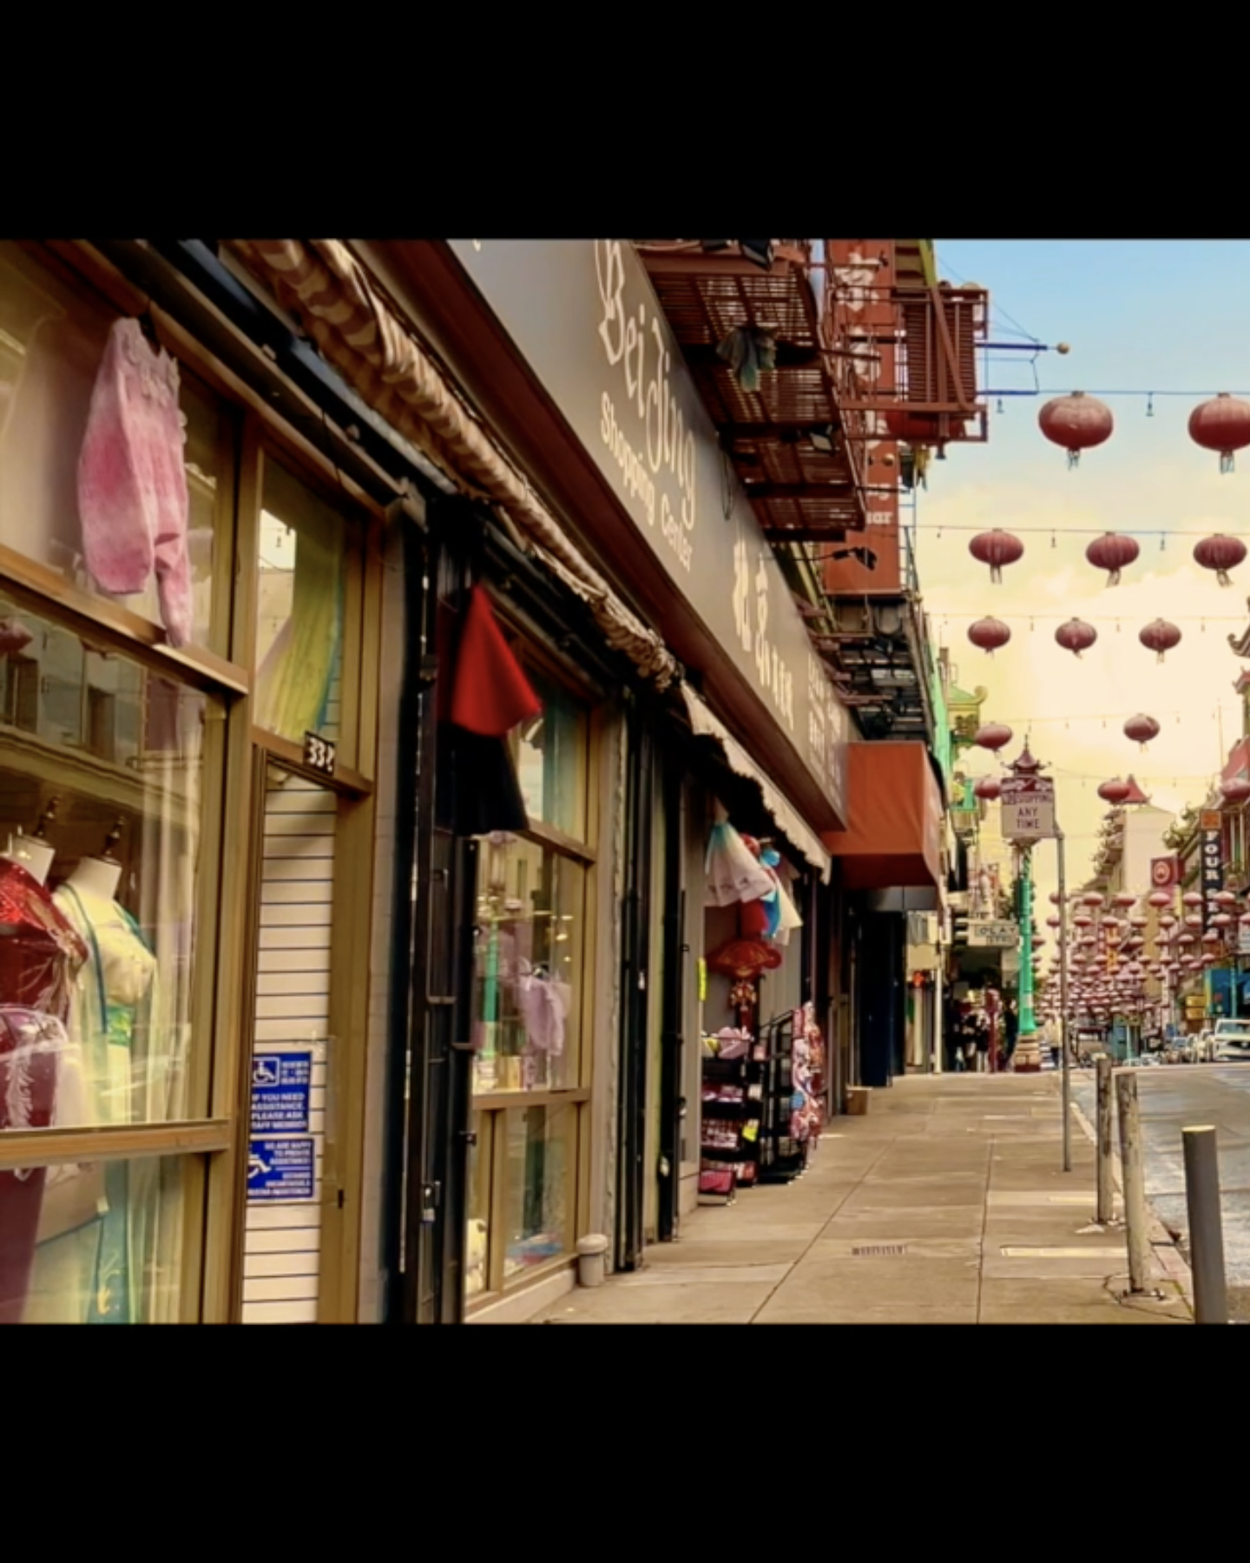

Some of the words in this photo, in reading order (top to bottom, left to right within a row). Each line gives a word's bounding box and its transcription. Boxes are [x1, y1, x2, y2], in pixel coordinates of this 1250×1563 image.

[601, 391, 655, 527] Shopping
[1016, 818, 1040, 830] TIME
[1018, 806, 1038, 818] ANY
[1204, 830, 1219, 880] FOUR
